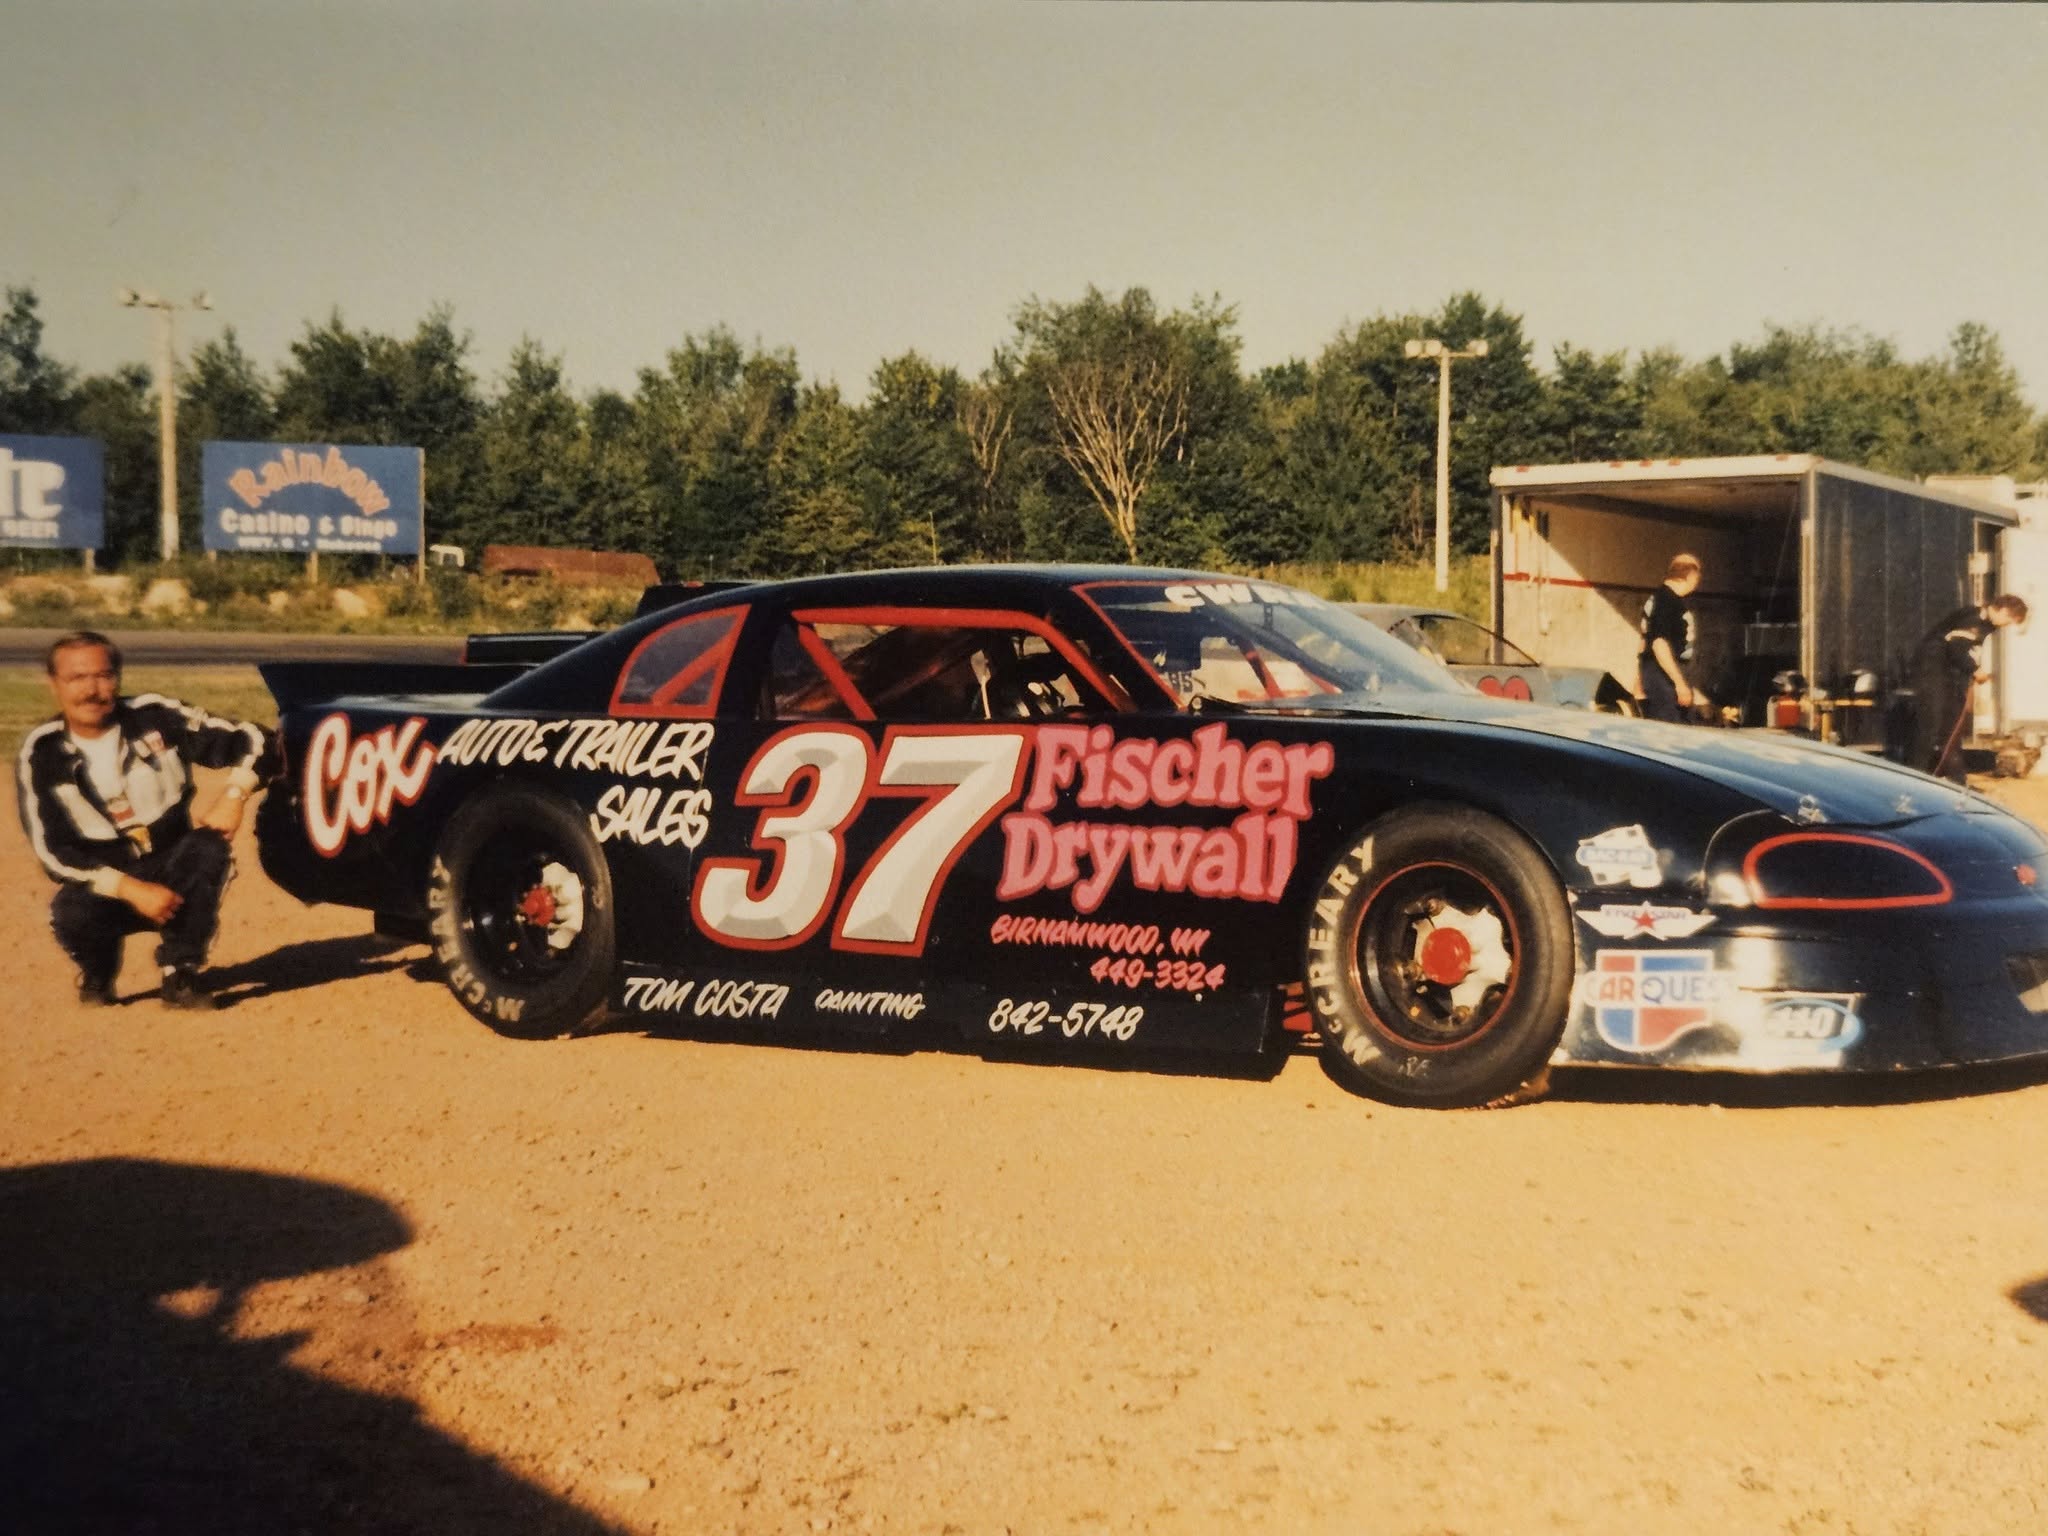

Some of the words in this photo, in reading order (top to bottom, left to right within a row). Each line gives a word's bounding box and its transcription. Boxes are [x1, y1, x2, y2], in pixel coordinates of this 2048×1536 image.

[228, 446, 391, 516] Rainbow
[220, 507, 310, 535] Casino
[304, 711, 438, 858] Cox
[436, 719, 531, 766] AUTO
[553, 719, 716, 781] TRAILER
[1026, 722, 1334, 819] Fischer
[590, 785, 713, 849] SALES
[692, 724, 1033, 957] 37
[997, 811, 1299, 913] Drywall
[622, 976, 696, 1014] TOM
[693, 979, 791, 1019] COSTA
[814, 988, 927, 1020] PAINTING
[1090, 956, 1227, 992] 449-3324
[988, 999, 1145, 1042] 842-5748
